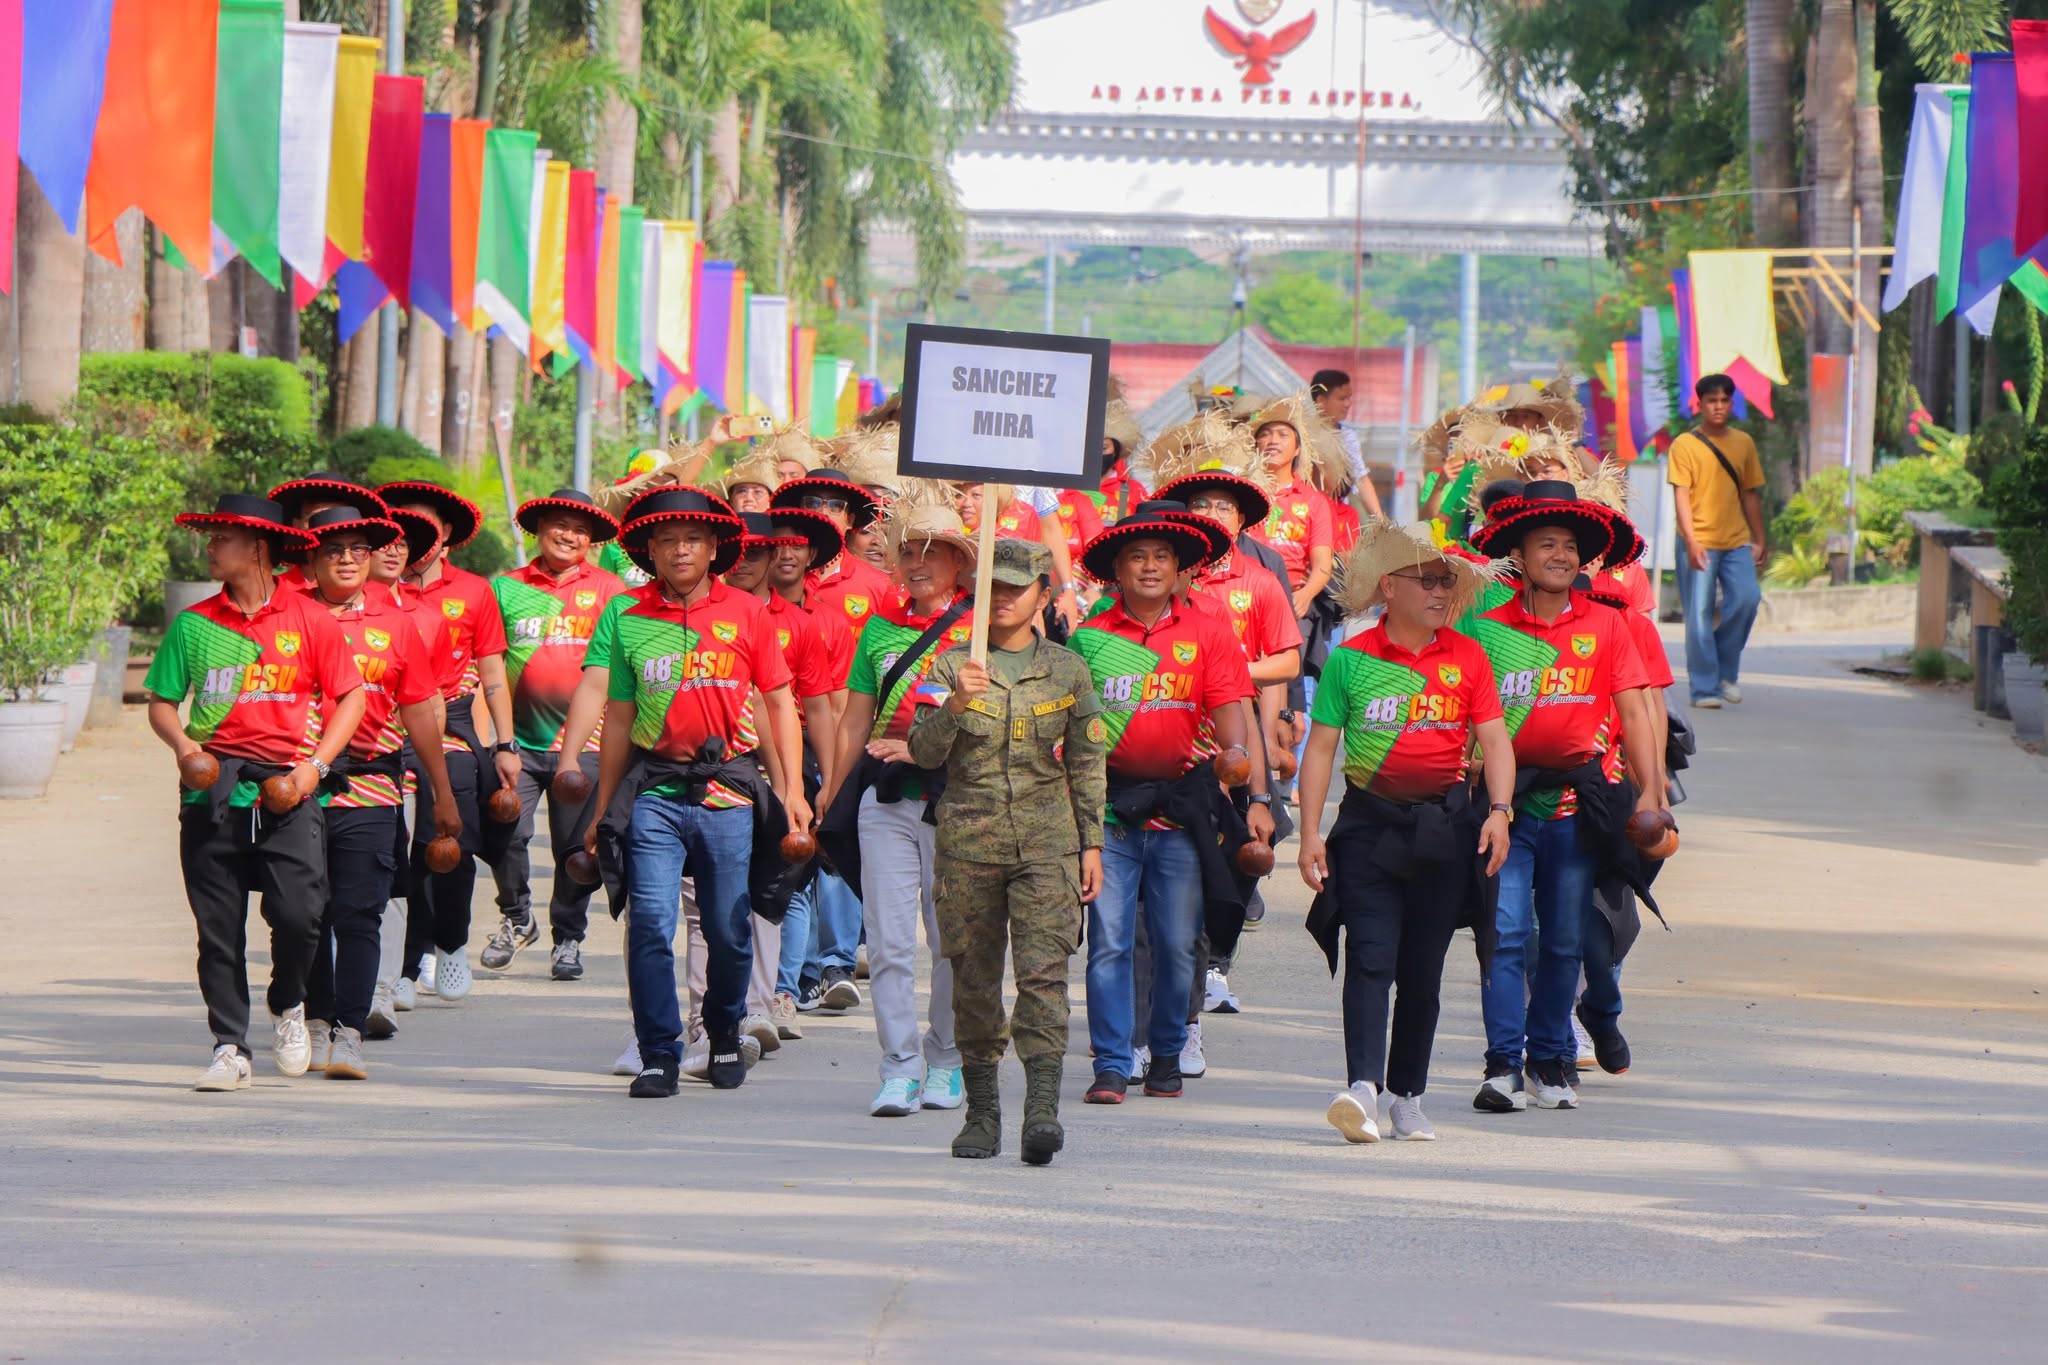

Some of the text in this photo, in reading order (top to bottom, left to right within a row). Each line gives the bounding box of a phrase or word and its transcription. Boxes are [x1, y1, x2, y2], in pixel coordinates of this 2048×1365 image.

[1091, 84, 1121, 101] AD
[1136, 86, 1222, 103] ASTRA
[952, 365, 1057, 398] SANCHEZ
[973, 410, 1034, 439] MIRA
[548, 615, 593, 638] CSU
[245, 663, 298, 692] CSU
[684, 650, 736, 679] CSU
[1142, 672, 1194, 700] CSU
[1540, 667, 1595, 695] CSU
[1036, 700, 1057, 714] ARMY
[1409, 693, 1461, 721] CSU
[714, 1053, 738, 1063] PUMA
